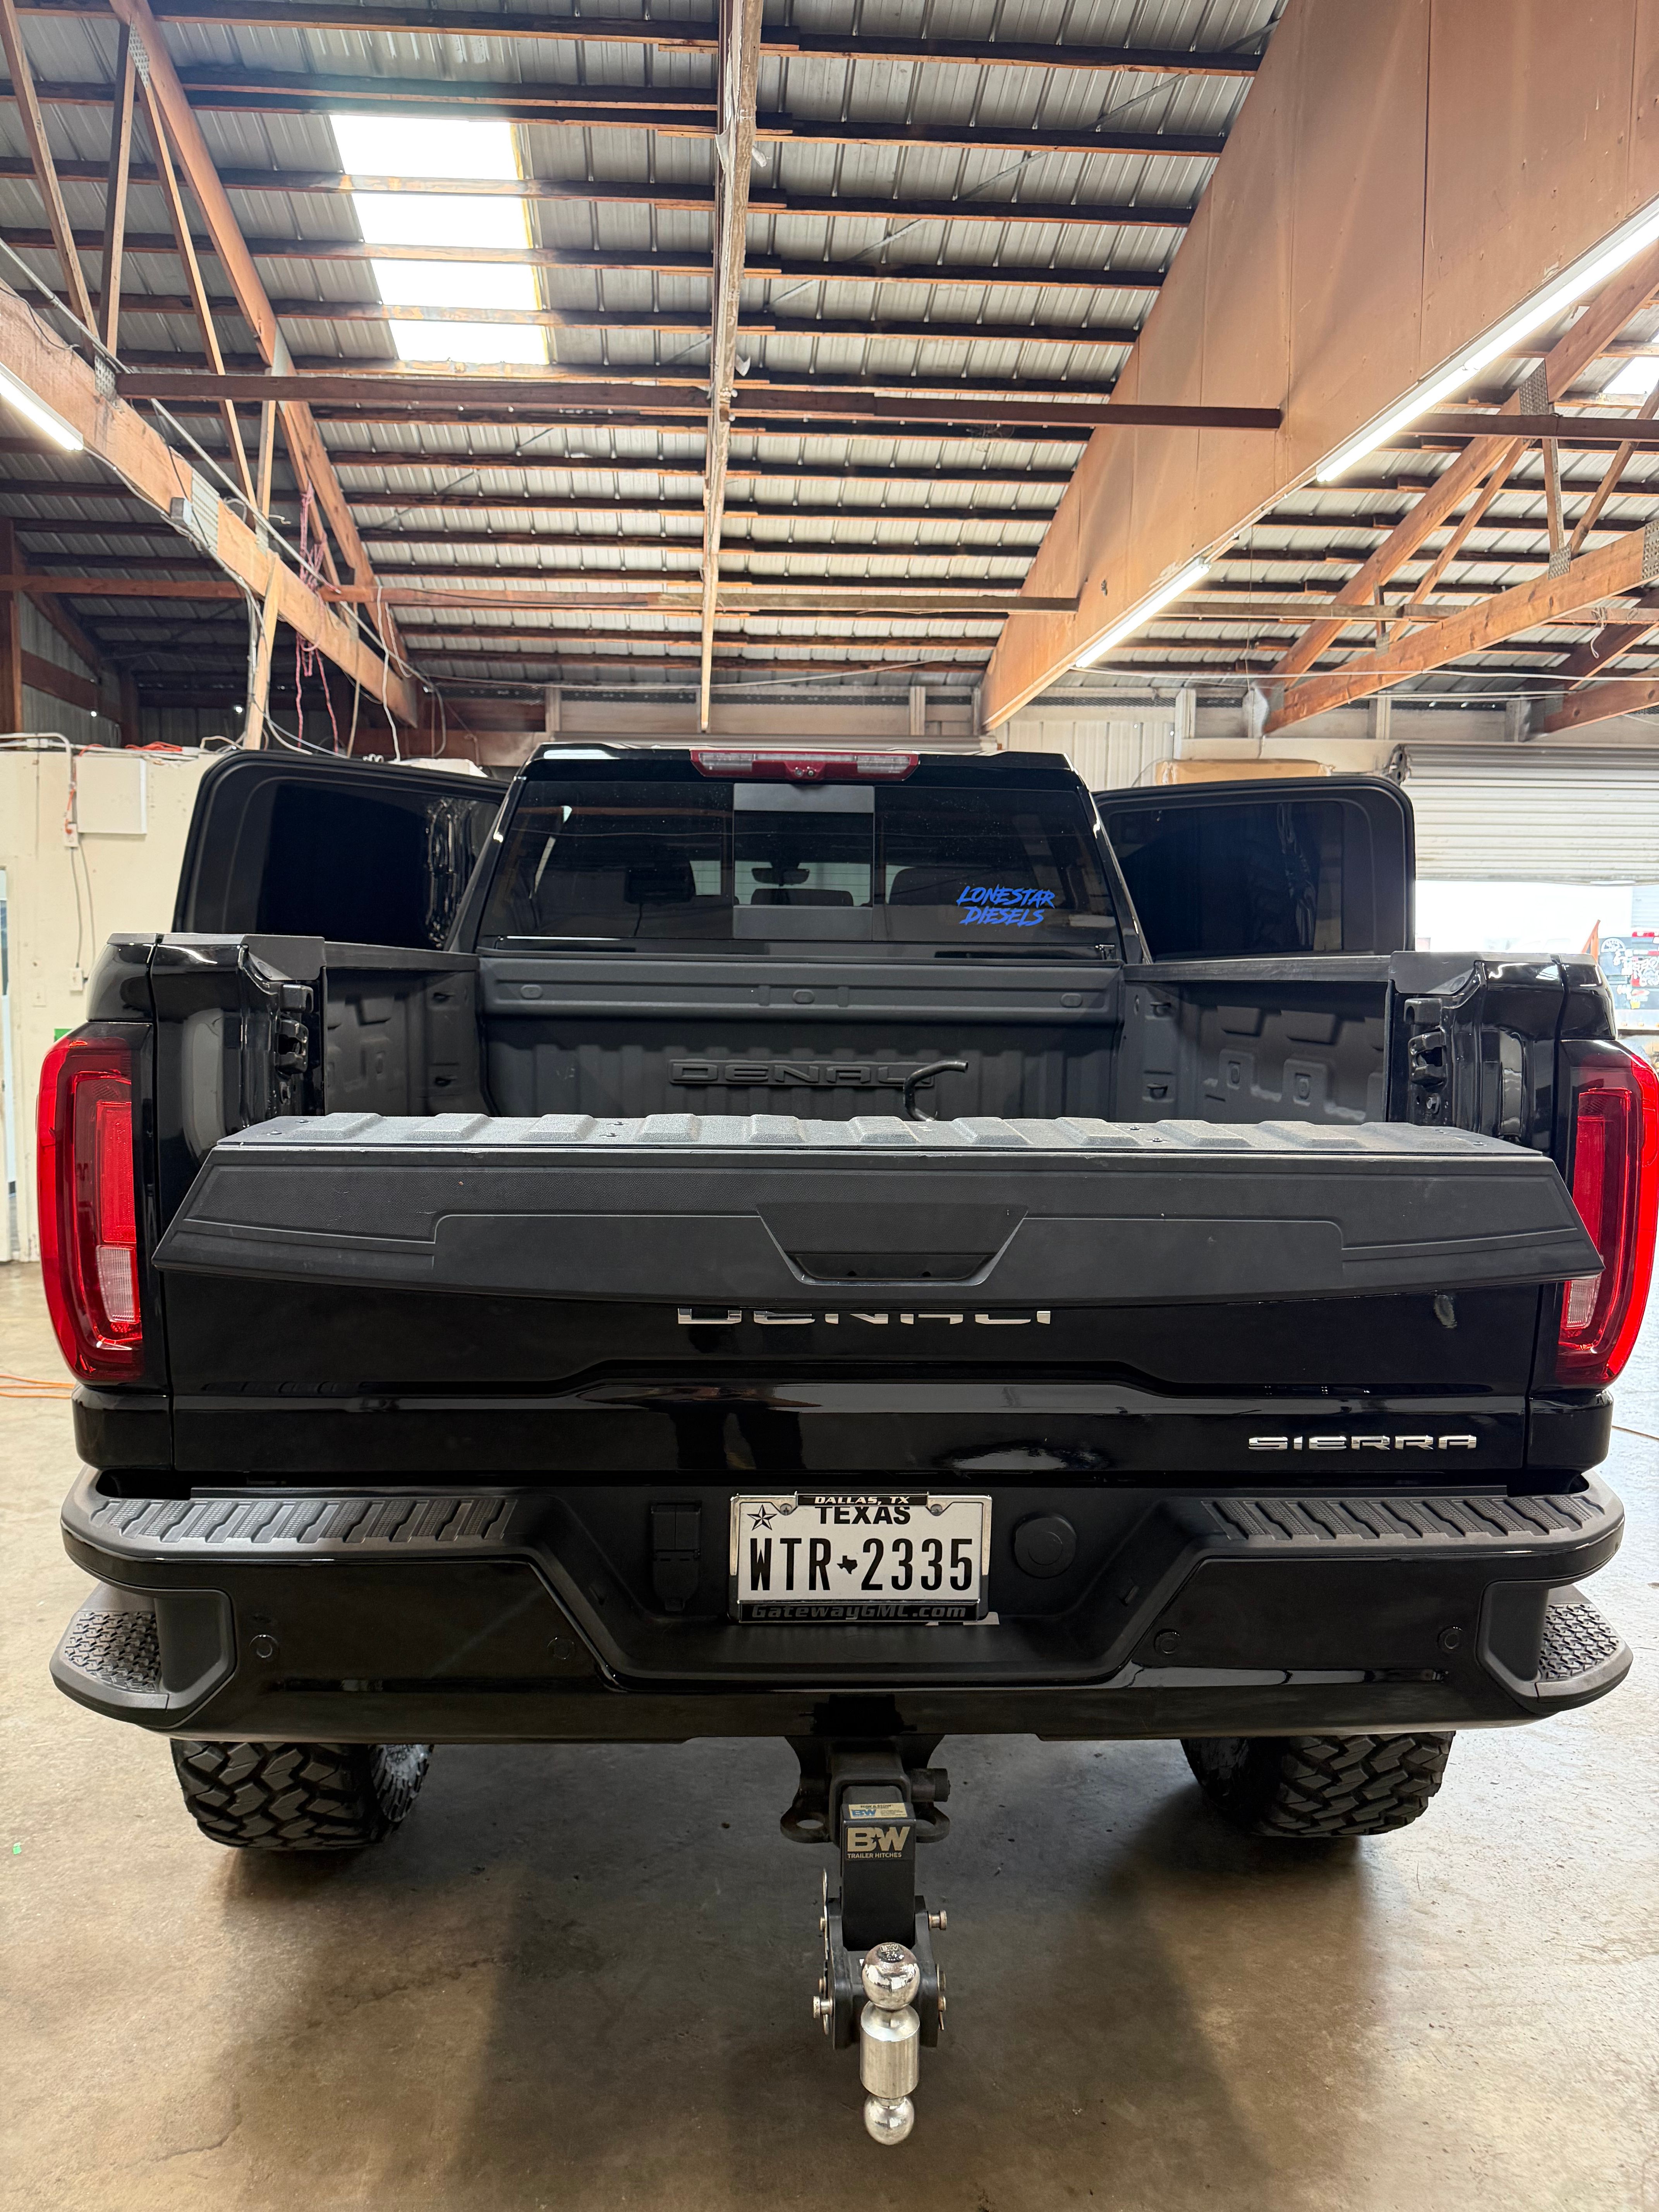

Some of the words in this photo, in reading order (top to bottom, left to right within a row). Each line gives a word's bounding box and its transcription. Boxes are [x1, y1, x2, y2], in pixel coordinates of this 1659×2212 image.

[956, 884, 1055, 908] LONESTAR
[959, 906, 1044, 927] DIESELS
[672, 1063, 930, 1084] DENAL
[1249, 1436, 1477, 1450] SIERRA
[814, 1496, 881, 1505] DALLAS,
[815, 1506, 911, 1525] TEXAS
[750, 1538, 831, 1591] WTR
[861, 1538, 972, 1591] 2335
[752, 1605, 966, 1620] GatewayGMC.com
